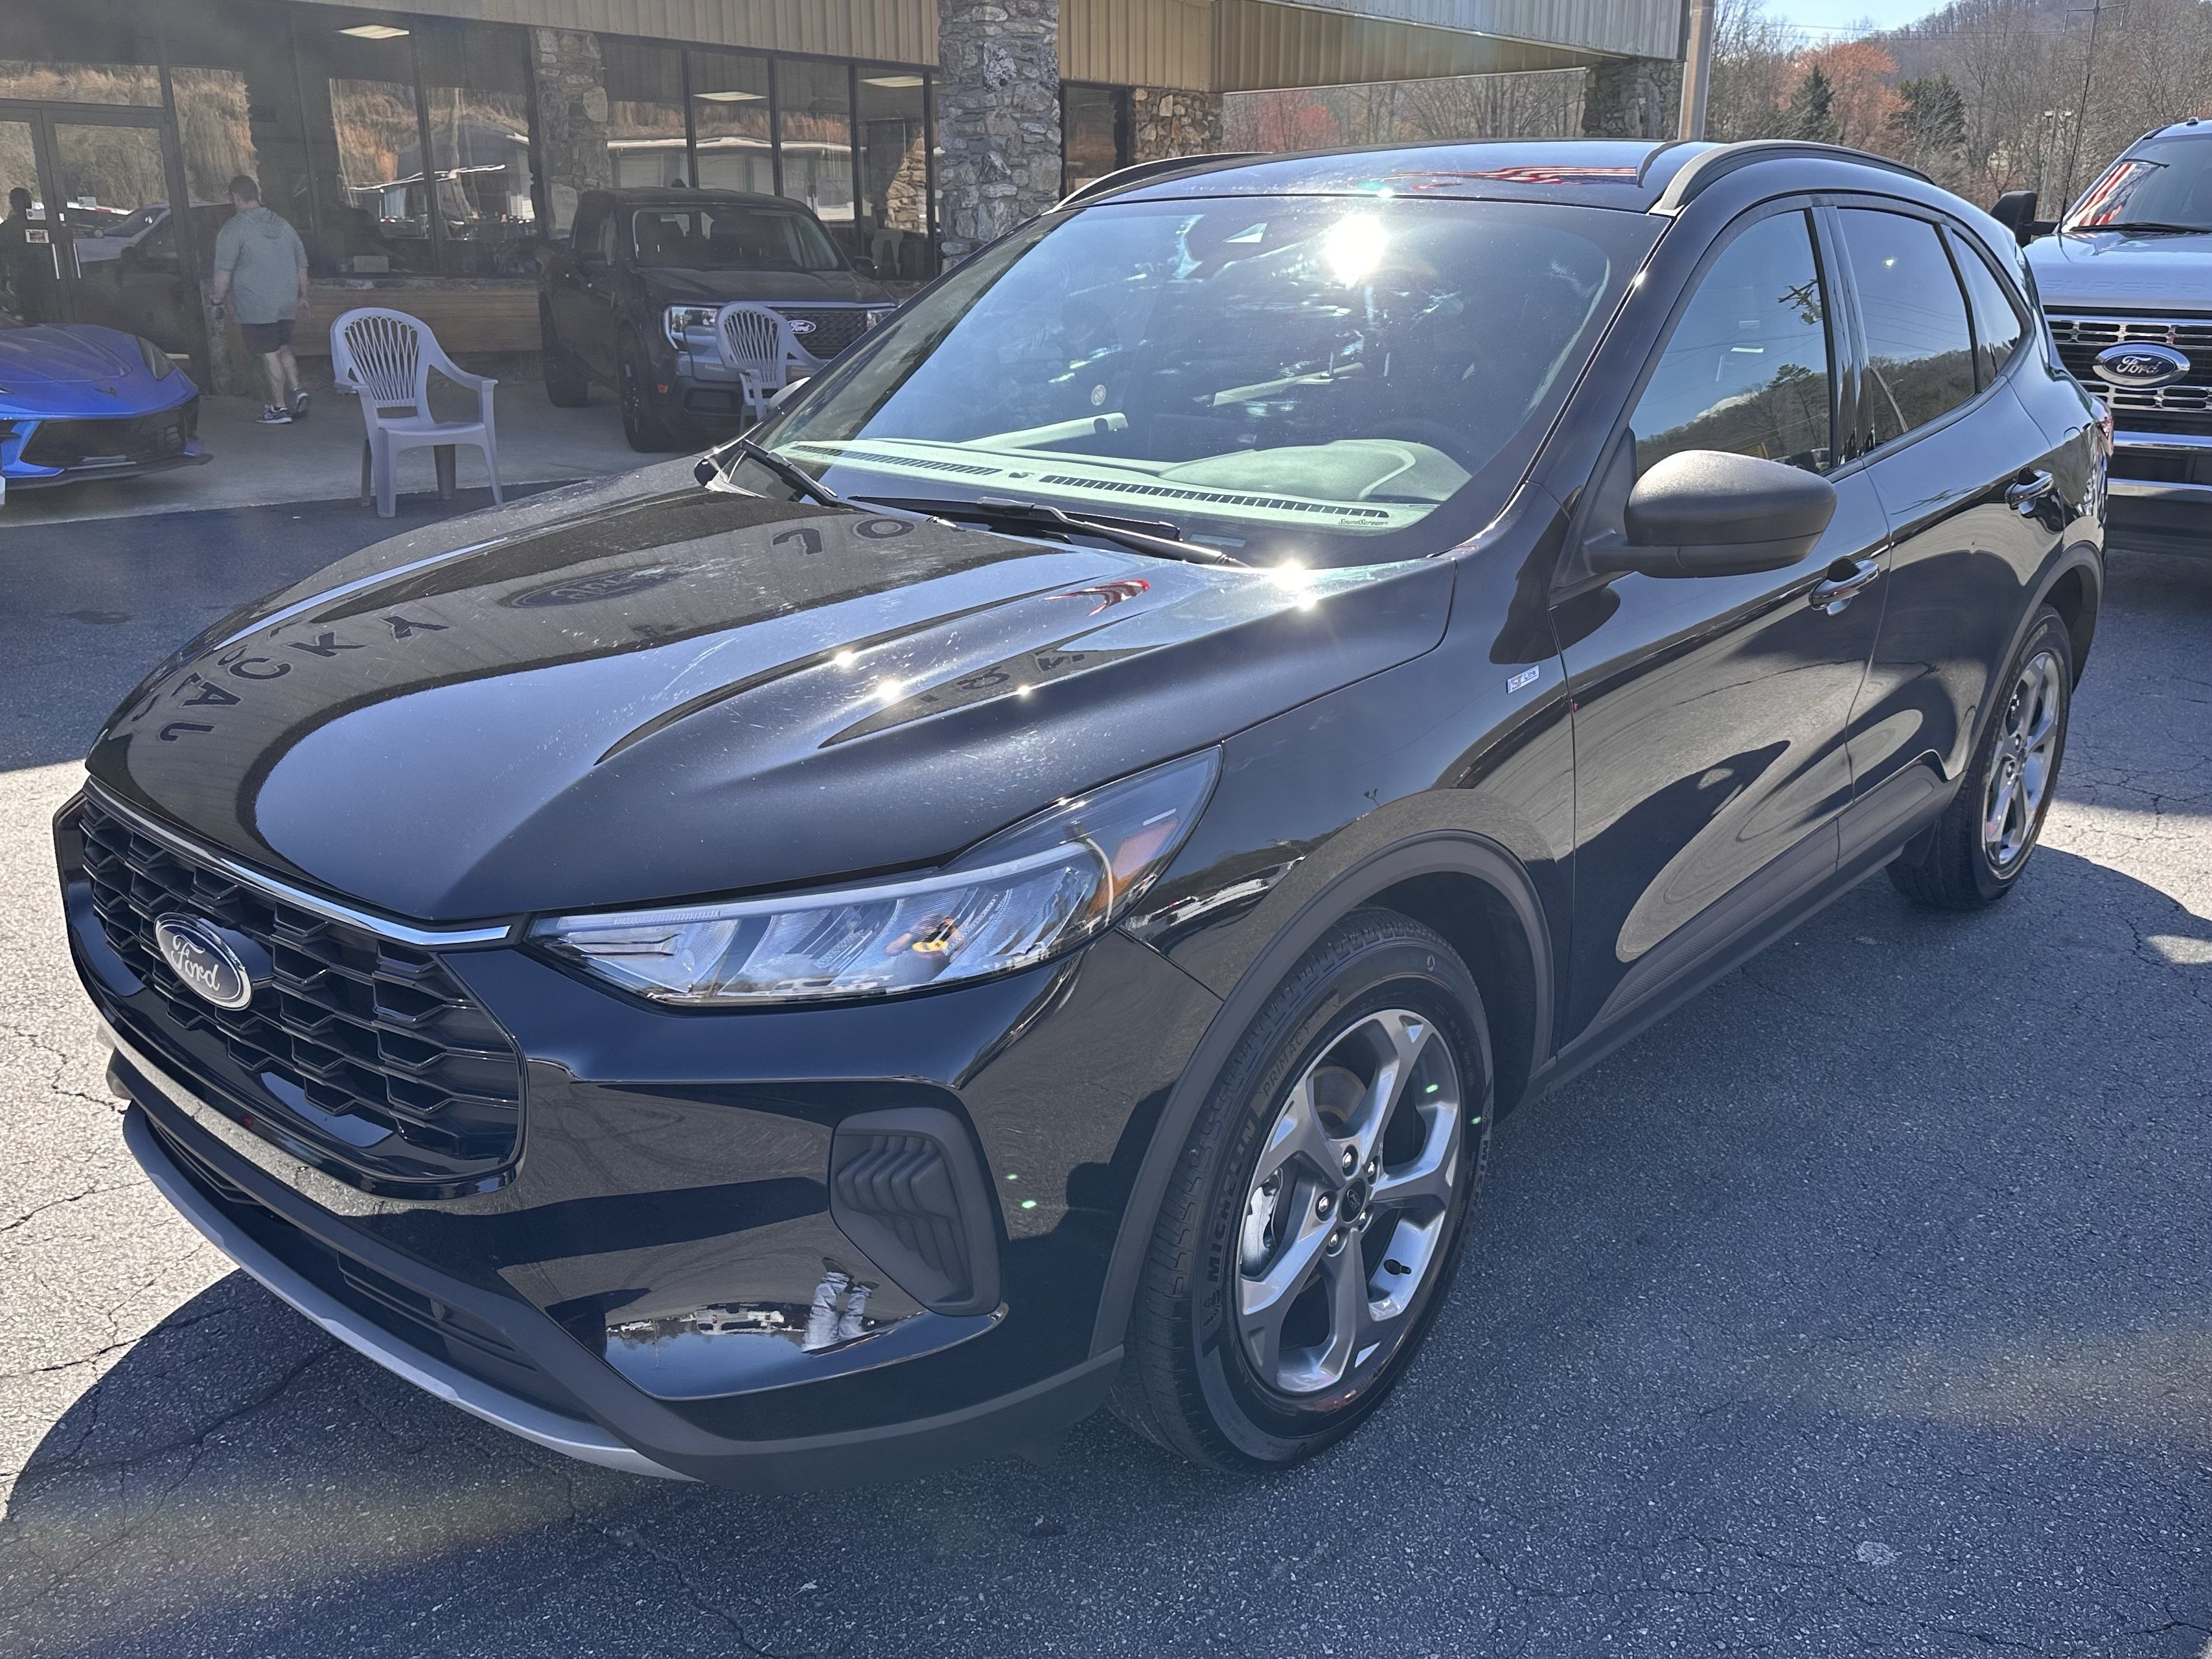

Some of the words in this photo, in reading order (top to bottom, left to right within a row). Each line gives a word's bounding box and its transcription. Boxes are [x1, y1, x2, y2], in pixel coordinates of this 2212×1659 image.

[790, 321, 811, 332] Ford
[2116, 355, 2162, 374] Ford
[170, 932, 221, 991] Ford
[1262, 1020, 1310, 1097] PRIMACY
[1206, 1117, 1258, 1283] MICHELIN
